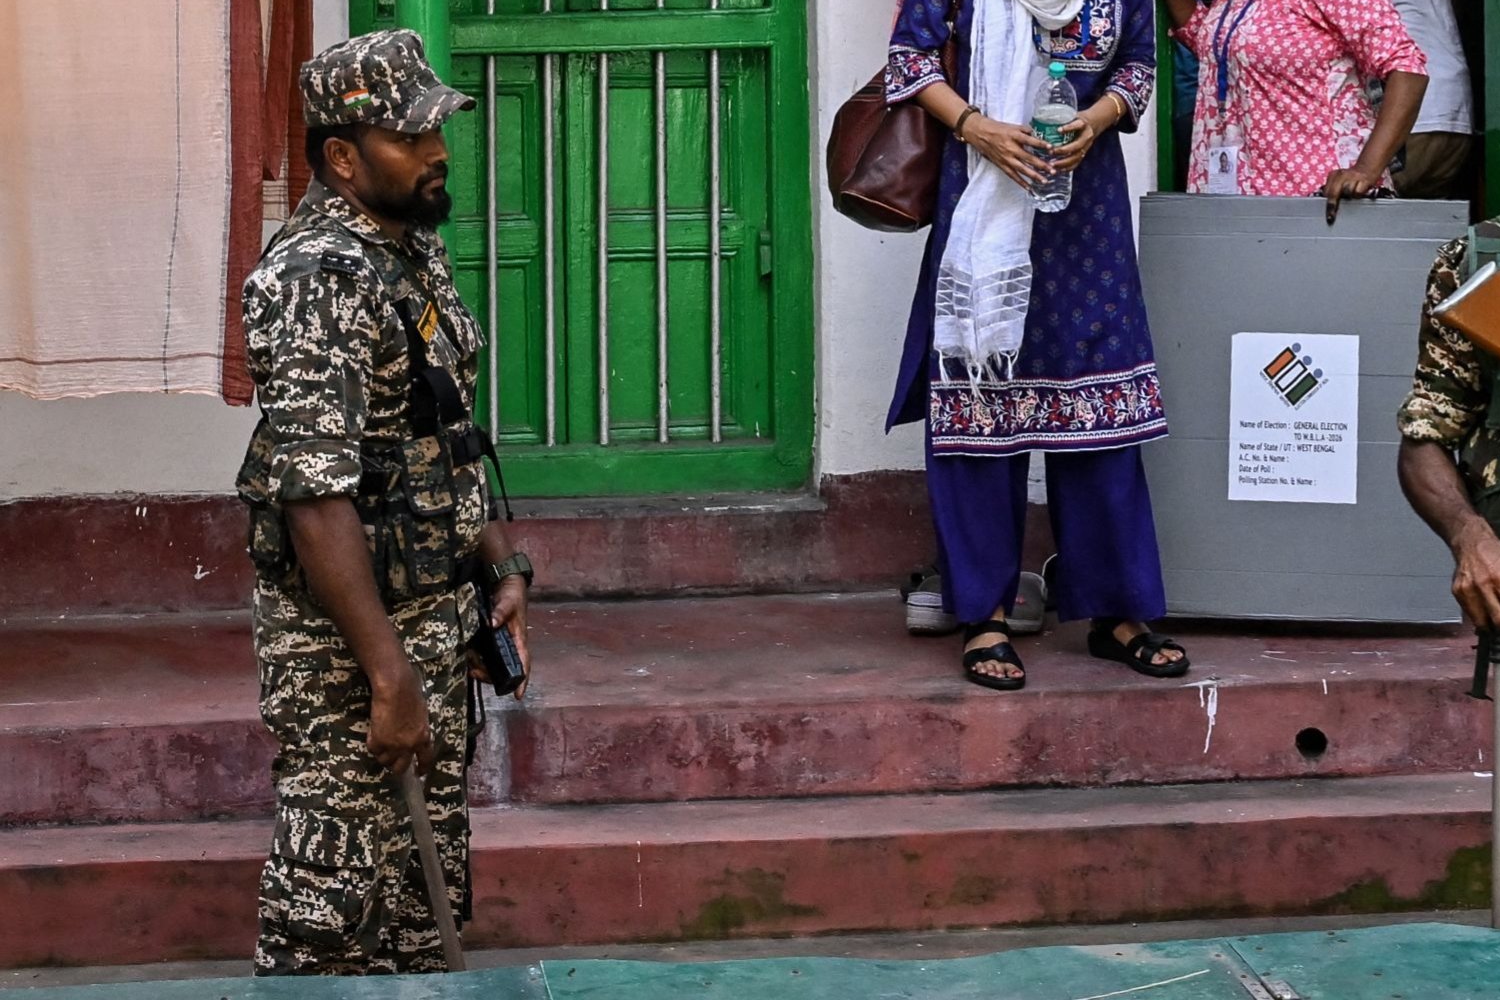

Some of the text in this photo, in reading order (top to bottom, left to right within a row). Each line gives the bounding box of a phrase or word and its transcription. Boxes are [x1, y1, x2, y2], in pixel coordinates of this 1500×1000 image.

[1240, 420, 1255, 428] Name
[1257, 420, 1263, 428] of
[1264, 420, 1287, 429] Election
[1294, 421, 1319, 430] GENERAL
[1320, 422, 1348, 431] ELECTION
[1294, 433, 1302, 441] TO
[1239, 443, 1255, 451] Name
[1257, 442, 1263, 451] of
[1264, 443, 1278, 451] State
[1284, 443, 1292, 452] UT
[1296, 444, 1312, 452] WEST
[1313, 444, 1335, 453] BENGAL
[1239, 464, 1252, 472] Date
[1253, 464, 1259, 473] of
[1260, 465, 1271, 473] Poll
[1239, 475, 1257, 486] Polling
[1258, 476, 1278, 484] Station
[1296, 478, 1313, 486] Name
